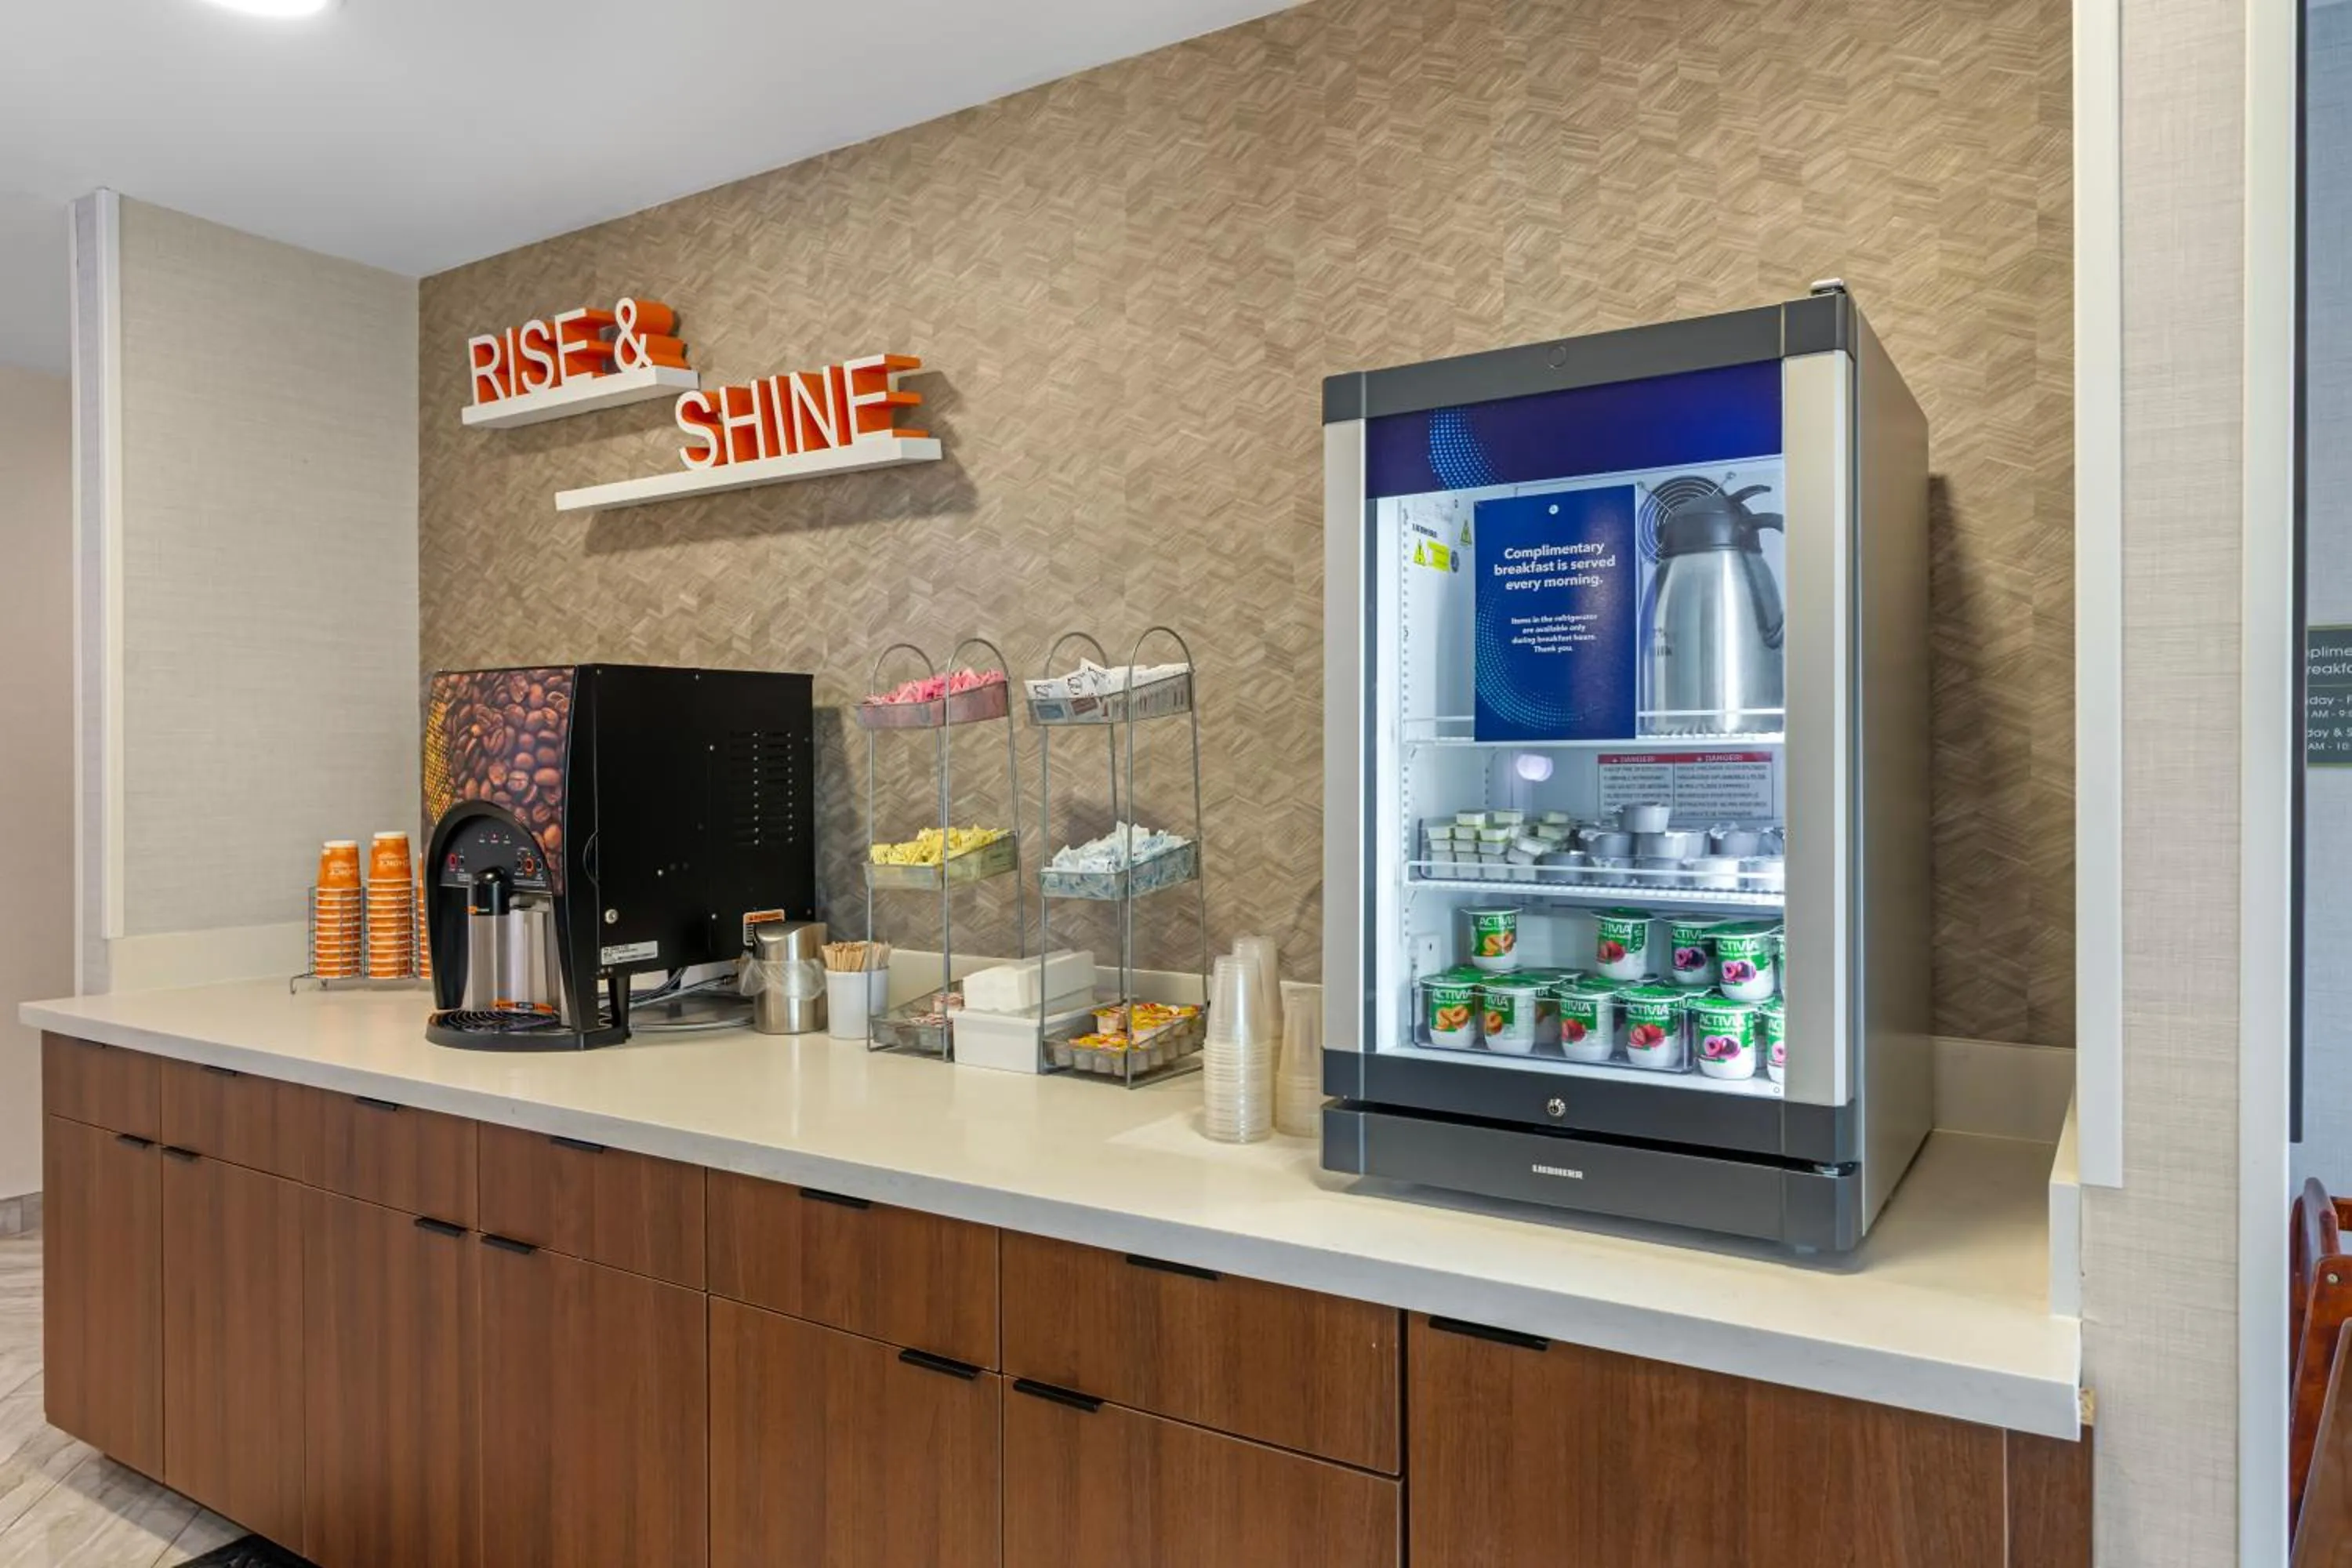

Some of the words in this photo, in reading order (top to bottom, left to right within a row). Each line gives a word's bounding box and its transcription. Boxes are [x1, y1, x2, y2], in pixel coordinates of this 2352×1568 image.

[468, 307, 586, 405] RISE
[615, 297, 653, 373] &
[675, 354, 894, 470] SHINE
[1504, 542, 1605, 561] Complimentary
[1494, 561, 1555, 576] breakfast
[1556, 559, 1568, 572] is
[1570, 554, 1617, 571] served
[1505, 579, 1542, 593] every
[1544, 573, 1604, 588] morning.
[1541, 615, 1553, 623] the
[1554, 614, 1598, 624] refrigerator
[1535, 624, 1569, 633] available
[1569, 624, 1585, 633] only
[1537, 634, 1572, 644] breakfast
[2308, 645, 2352, 660] plime
[2307, 662, 2352, 675] reakf
